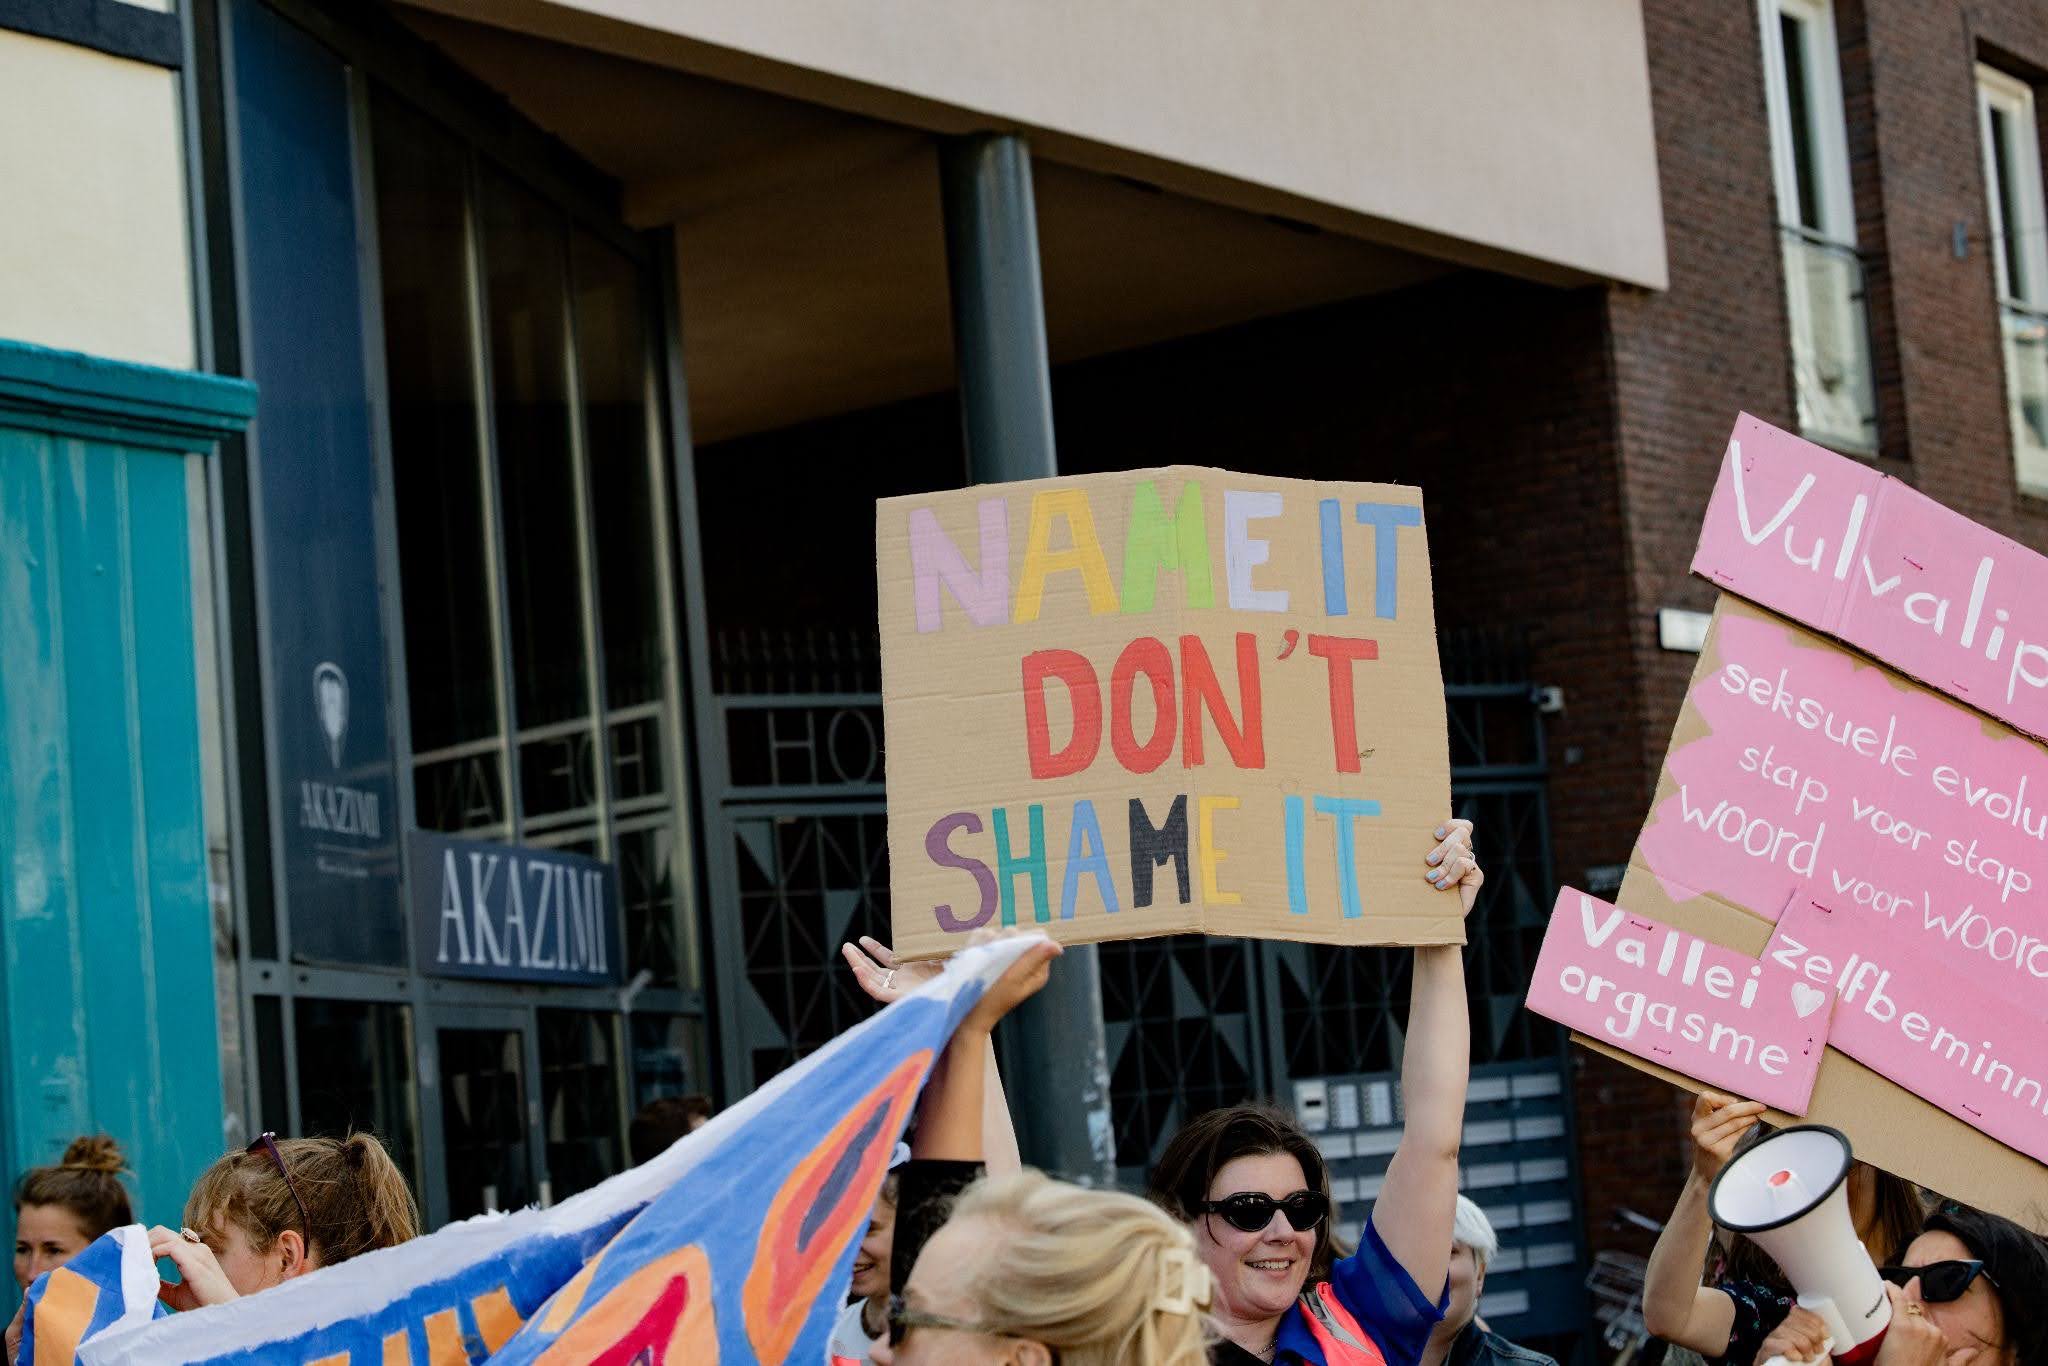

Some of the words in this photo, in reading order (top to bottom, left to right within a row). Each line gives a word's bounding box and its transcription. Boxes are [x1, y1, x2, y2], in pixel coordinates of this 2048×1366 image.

[908, 480, 1290, 633] NAME
[1318, 497, 1422, 620] IT
[1731, 439, 2048, 705] Vulvalip
[1021, 629, 1380, 780] DON'T
[1720, 663, 1918, 777] seksuele
[925, 794, 1242, 934] SHAME
[1284, 794, 1382, 919] IT
[1738, 745, 1829, 816] stap
[1851, 796, 1931, 851] voor
[1943, 838, 2033, 903] stap
[1832, 869, 1915, 919] voor
[1559, 964, 1791, 1076] orgasme
[1580, 895, 1763, 1009] Vallei
[1771, 932, 2048, 1116] zelfbeminn
